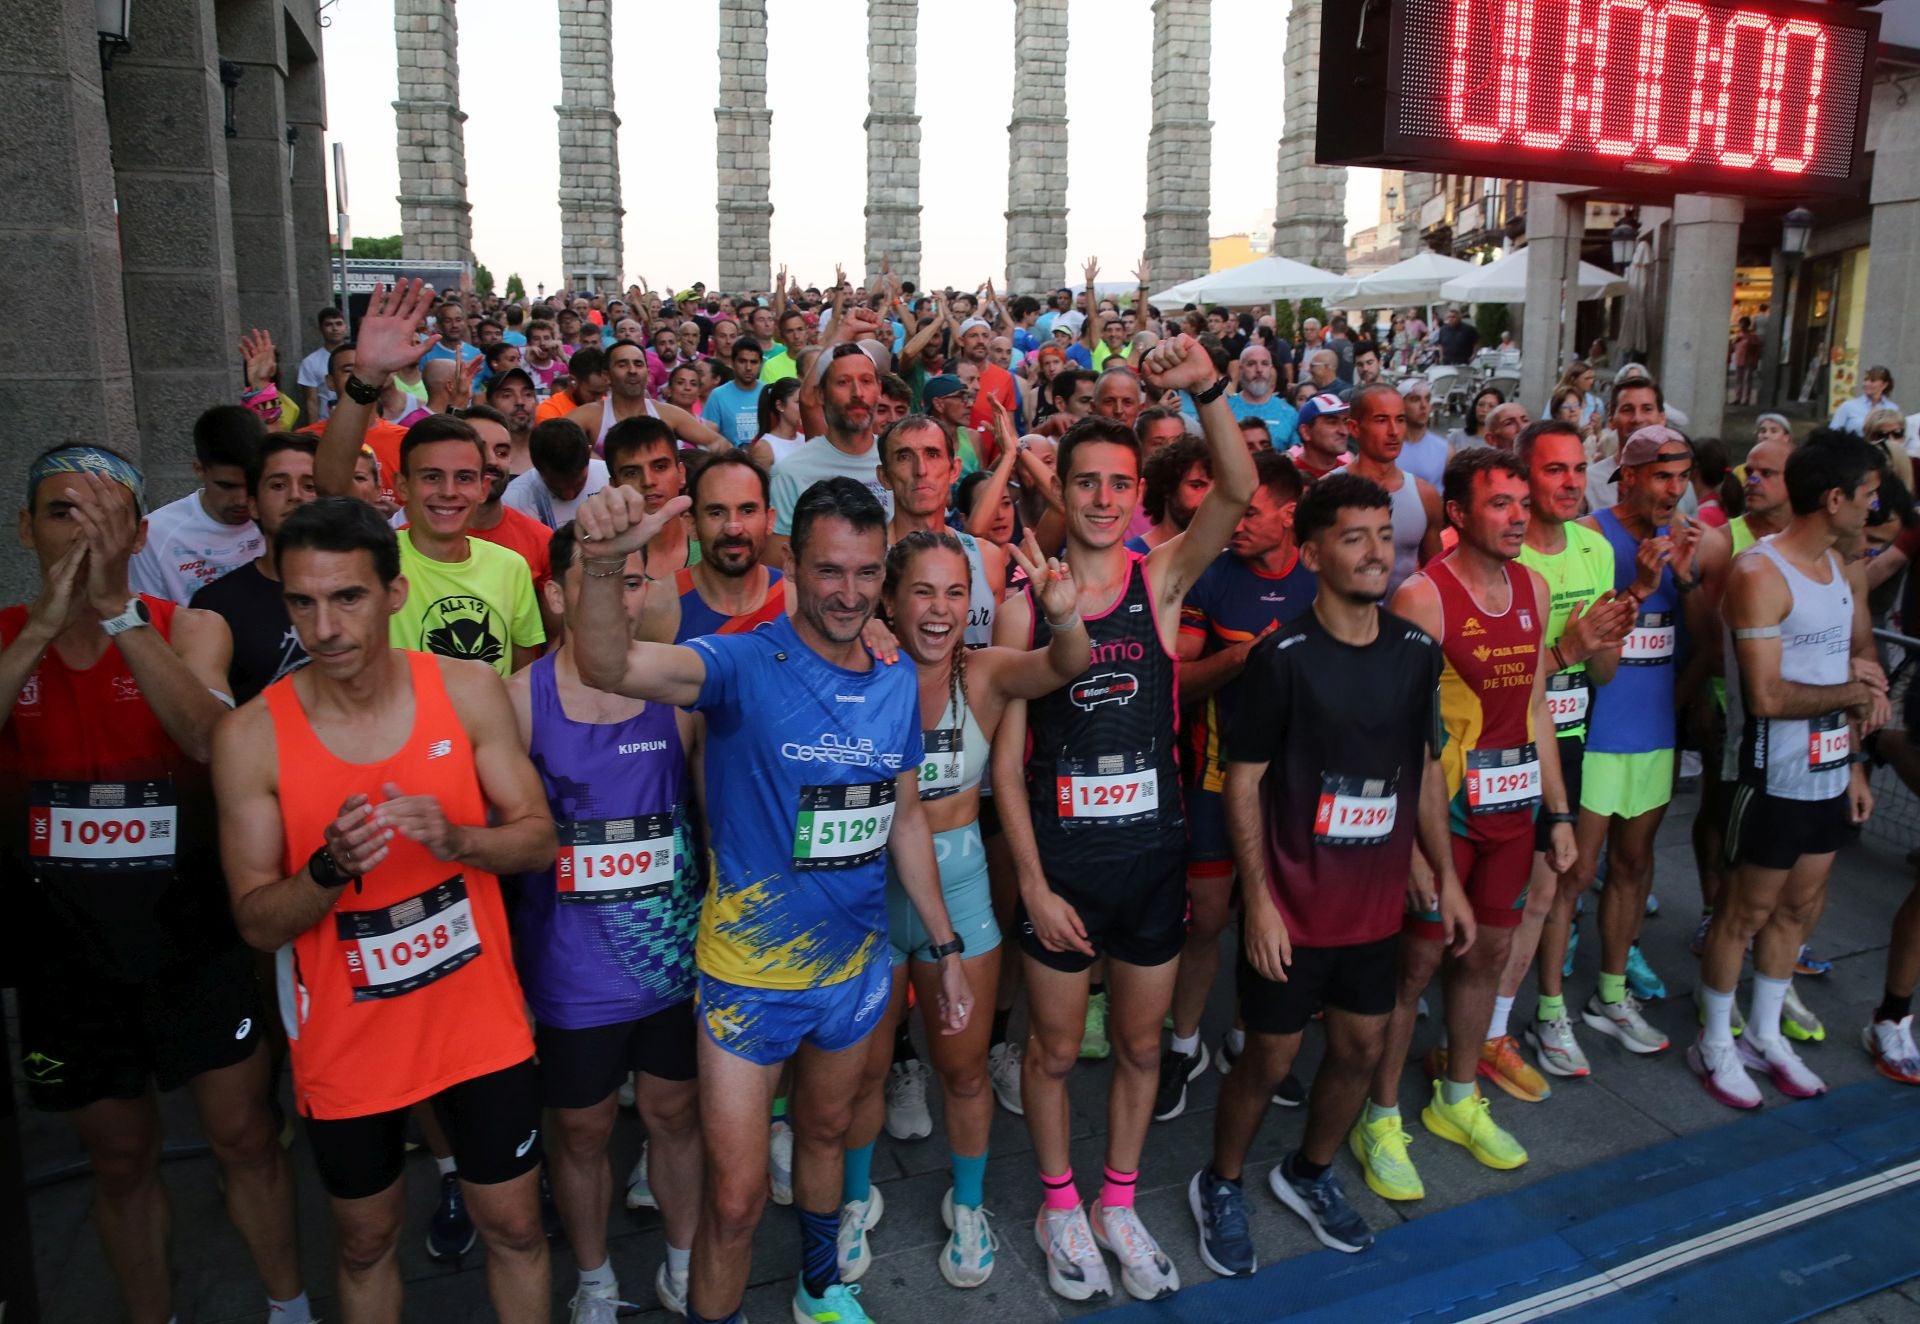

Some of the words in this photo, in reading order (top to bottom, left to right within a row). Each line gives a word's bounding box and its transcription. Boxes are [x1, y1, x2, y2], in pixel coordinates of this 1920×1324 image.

[440, 599, 467, 615] ALA
[469, 600, 484, 614] 12
[1494, 662, 1526, 676] VINO
[1483, 677, 1501, 690] DE
[1501, 674, 1534, 688] TORO
[1547, 698, 1576, 714] 352
[618, 740, 668, 755] KIPRUN
[821, 733, 873, 752] CLUB
[1486, 772, 1528, 794] 1292
[1061, 785, 1071, 805] 10K
[1080, 782, 1139, 806] 1297
[1340, 806, 1389, 826] 1239
[34, 818, 48, 841] 10K
[60, 819, 146, 845] 1090
[798, 825, 811, 841] 5K
[818, 817, 877, 845] 5129
[560, 856, 572, 878] 10K
[583, 851, 652, 879] 1309
[371, 923, 450, 971] 1038
[345, 949, 363, 973] 10K
